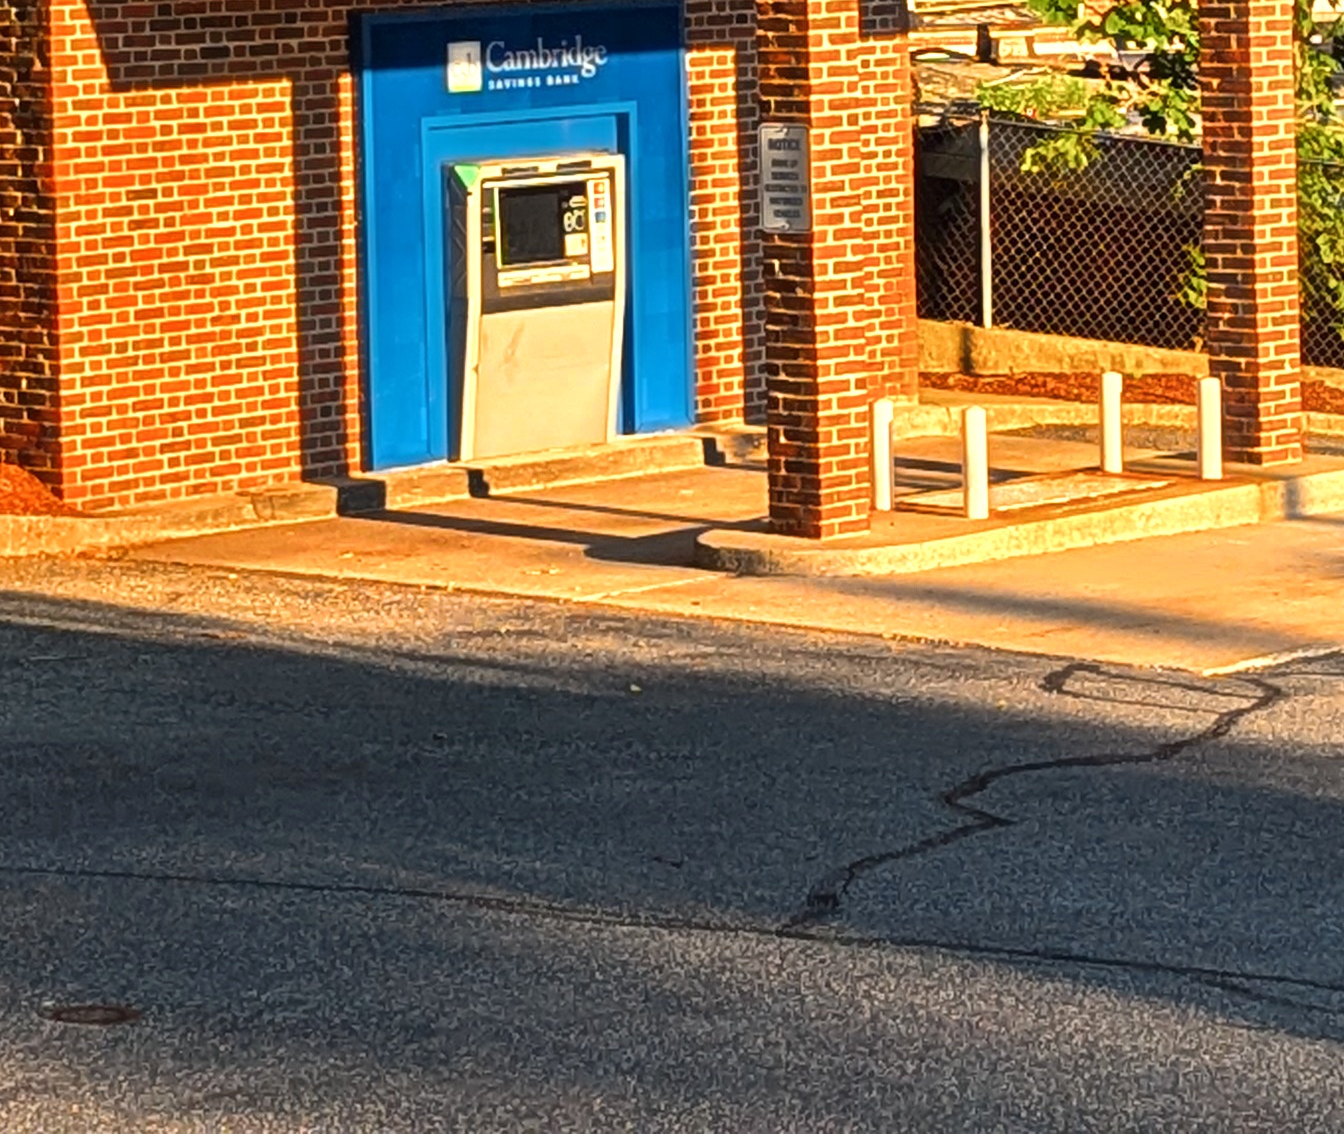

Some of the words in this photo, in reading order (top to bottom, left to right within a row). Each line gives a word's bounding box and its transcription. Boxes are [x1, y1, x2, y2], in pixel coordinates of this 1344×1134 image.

[486, 35, 609, 78] Cambridge
[488, 76, 541, 91] SAVINGS
[546, 74, 580, 87] BANK
